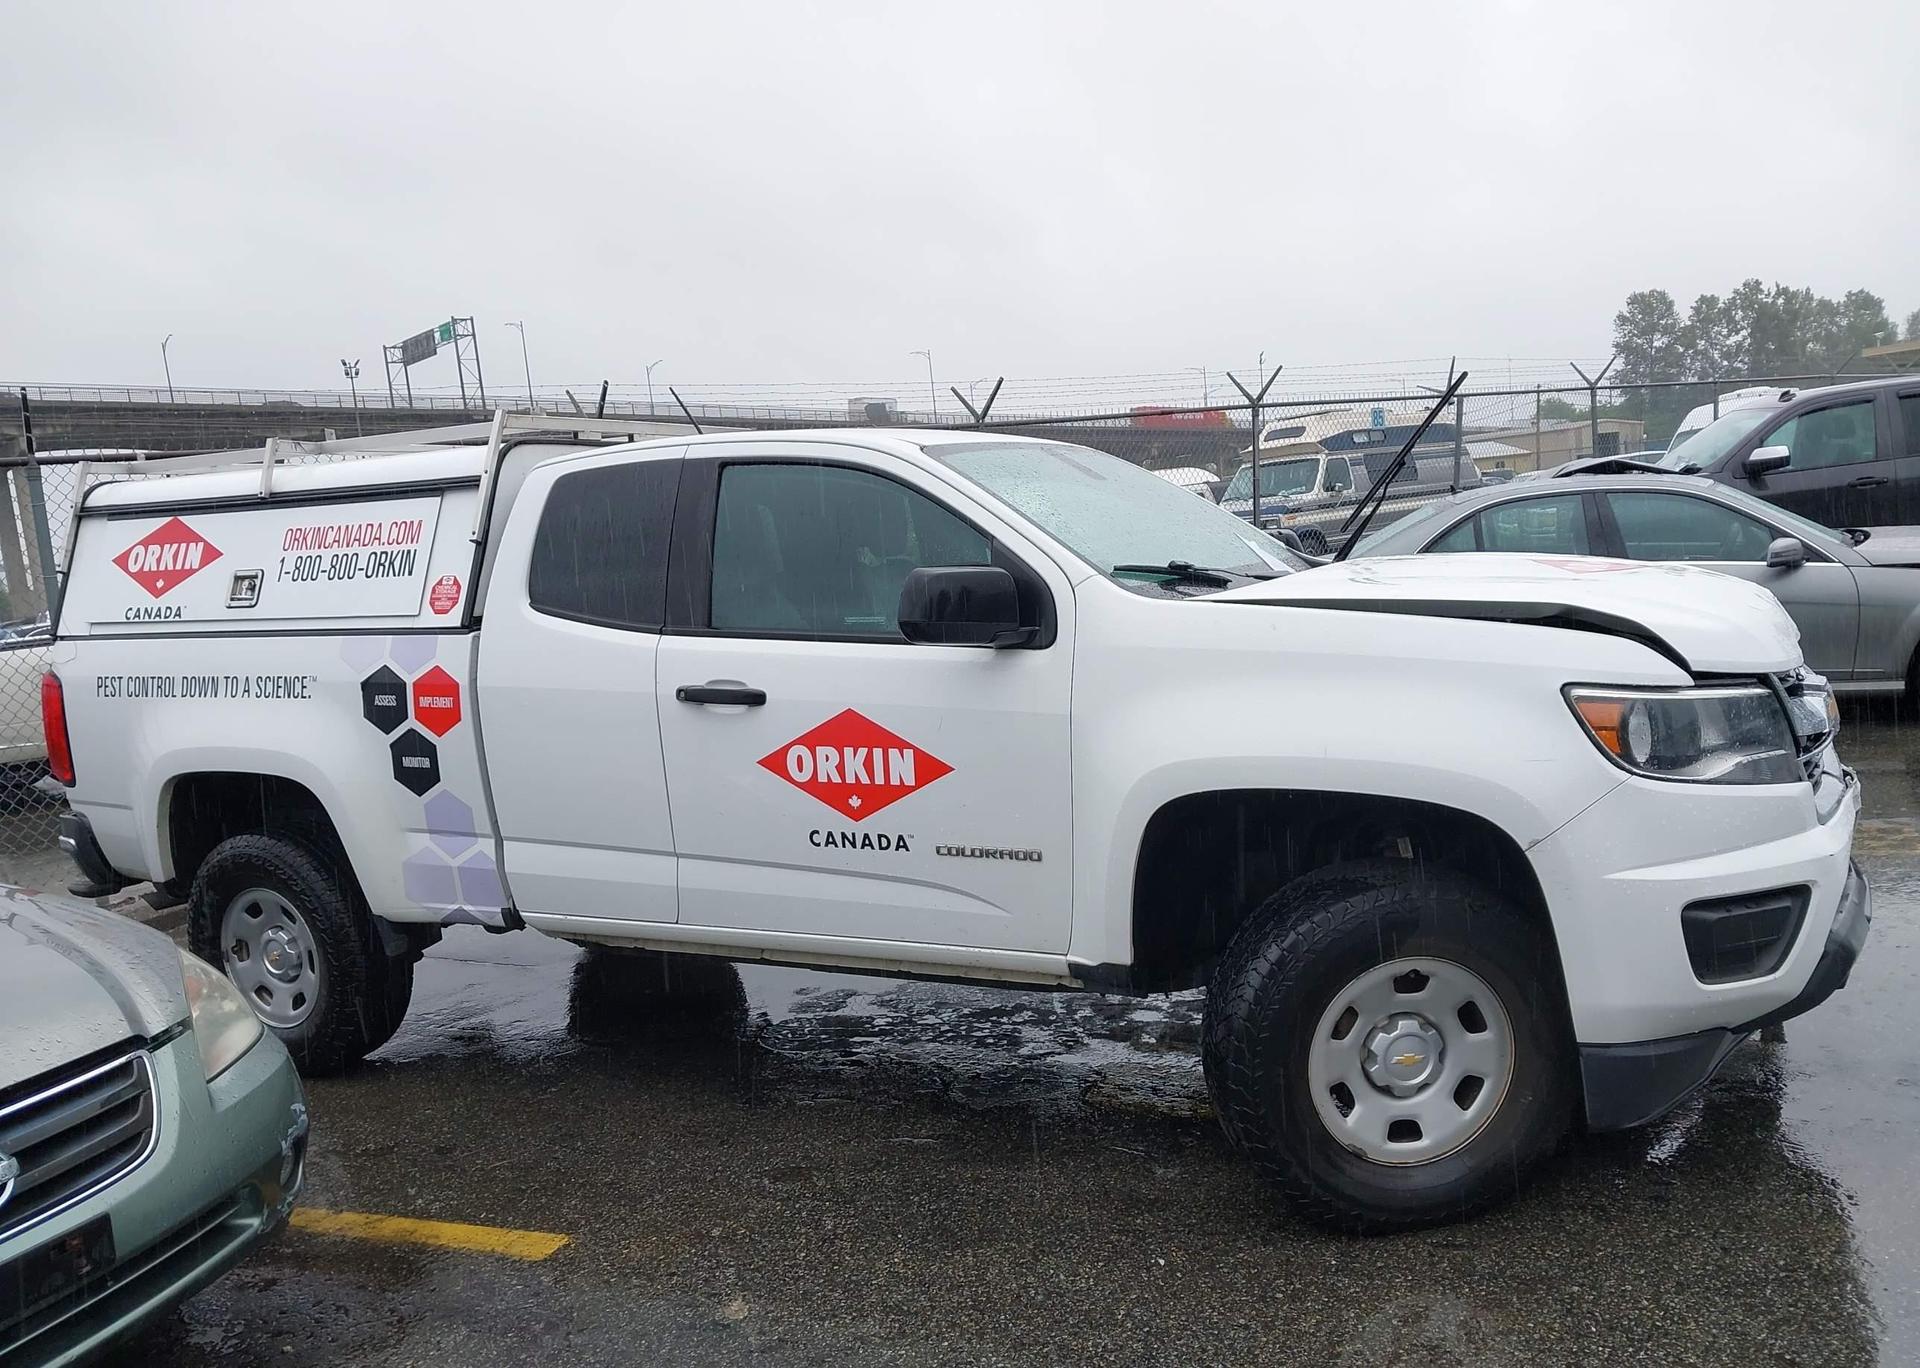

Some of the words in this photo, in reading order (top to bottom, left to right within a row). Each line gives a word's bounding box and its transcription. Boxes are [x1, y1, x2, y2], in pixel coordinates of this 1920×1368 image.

[1373, 410, 1384, 427] 85
[282, 519, 423, 552] ORKINCANADA.COM
[127, 541, 204, 573] ORKIN
[277, 548, 417, 583] 1-800-800-ORKIN
[125, 606, 182, 620] CANADA
[97, 676, 123, 698] PEST
[126, 676, 177, 698] CONTROL
[181, 676, 219, 698] DOWN
[223, 676, 239, 698] TO
[241, 676, 251, 698] A
[374, 694, 397, 706] ASSESS
[419, 696, 453, 708] IMPLEMENT
[402, 756, 431, 768] MONITOR
[786, 744, 916, 786] ORKIN
[935, 843, 1043, 862] COLORADO
